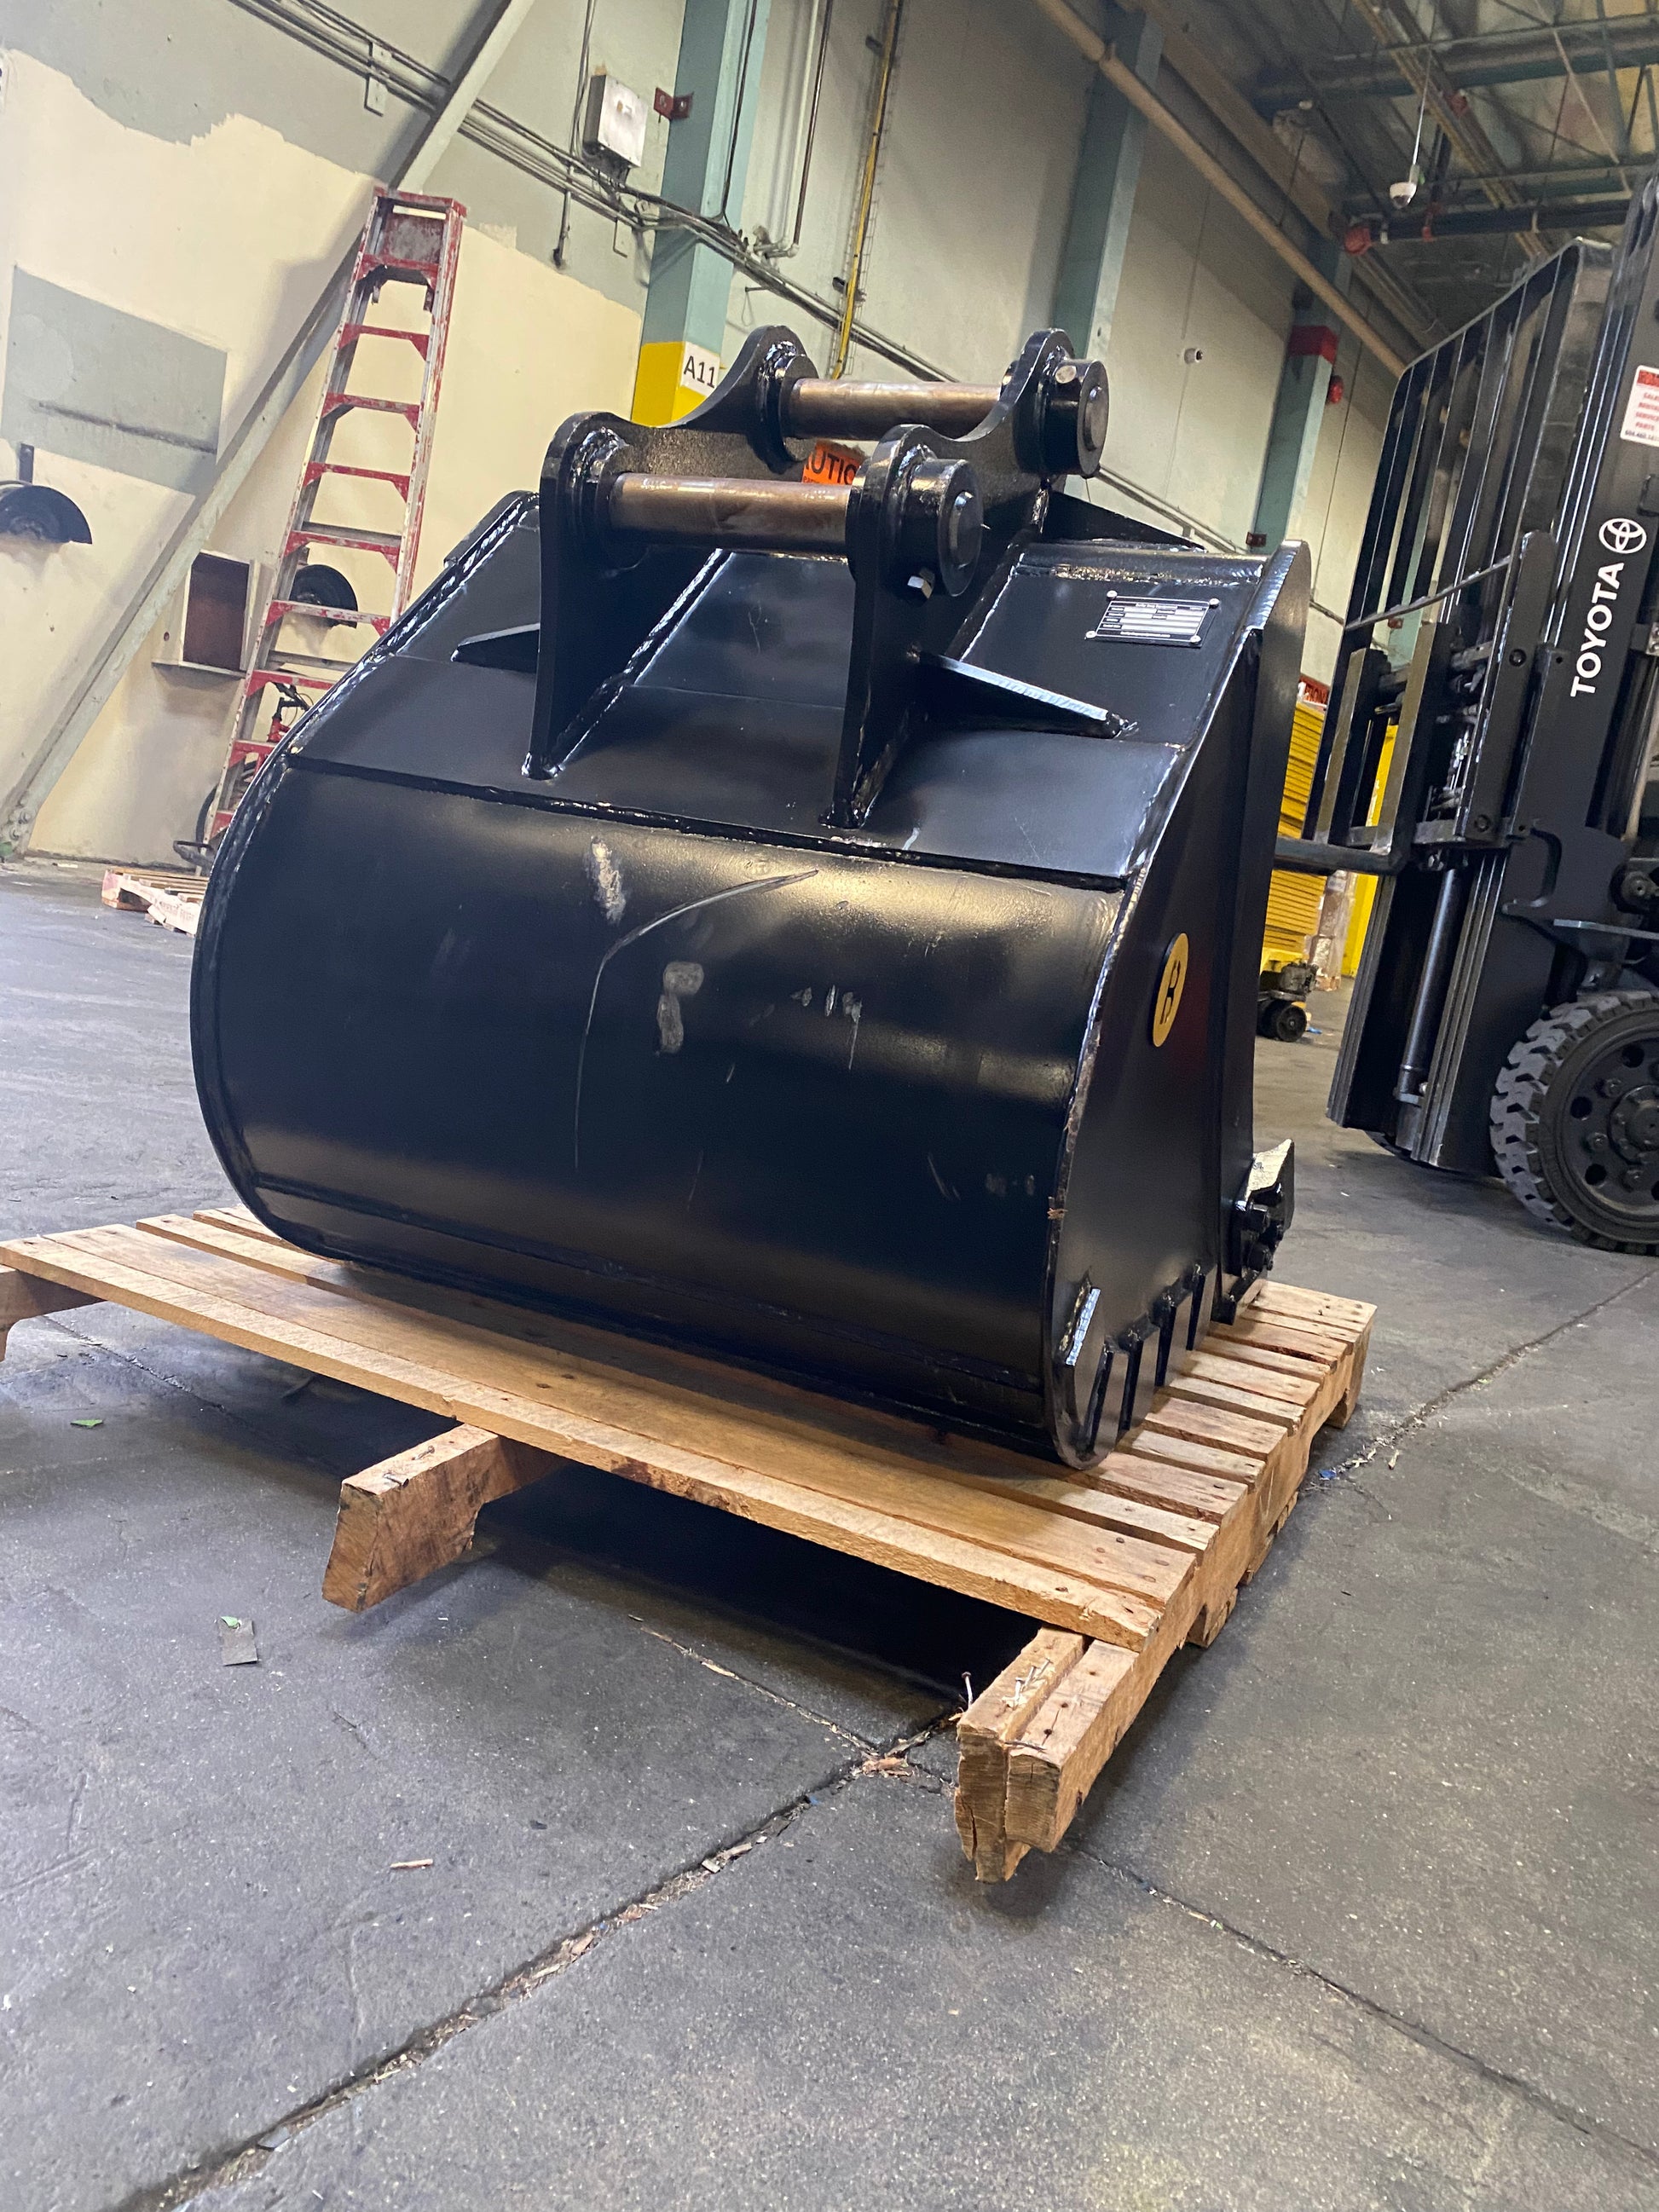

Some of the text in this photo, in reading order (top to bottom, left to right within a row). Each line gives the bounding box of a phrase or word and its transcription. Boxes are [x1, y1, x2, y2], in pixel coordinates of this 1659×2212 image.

[684, 355, 715, 389] A11
[806, 451, 856, 485] UTIO
[1569, 562, 1625, 697] TOYOTA
